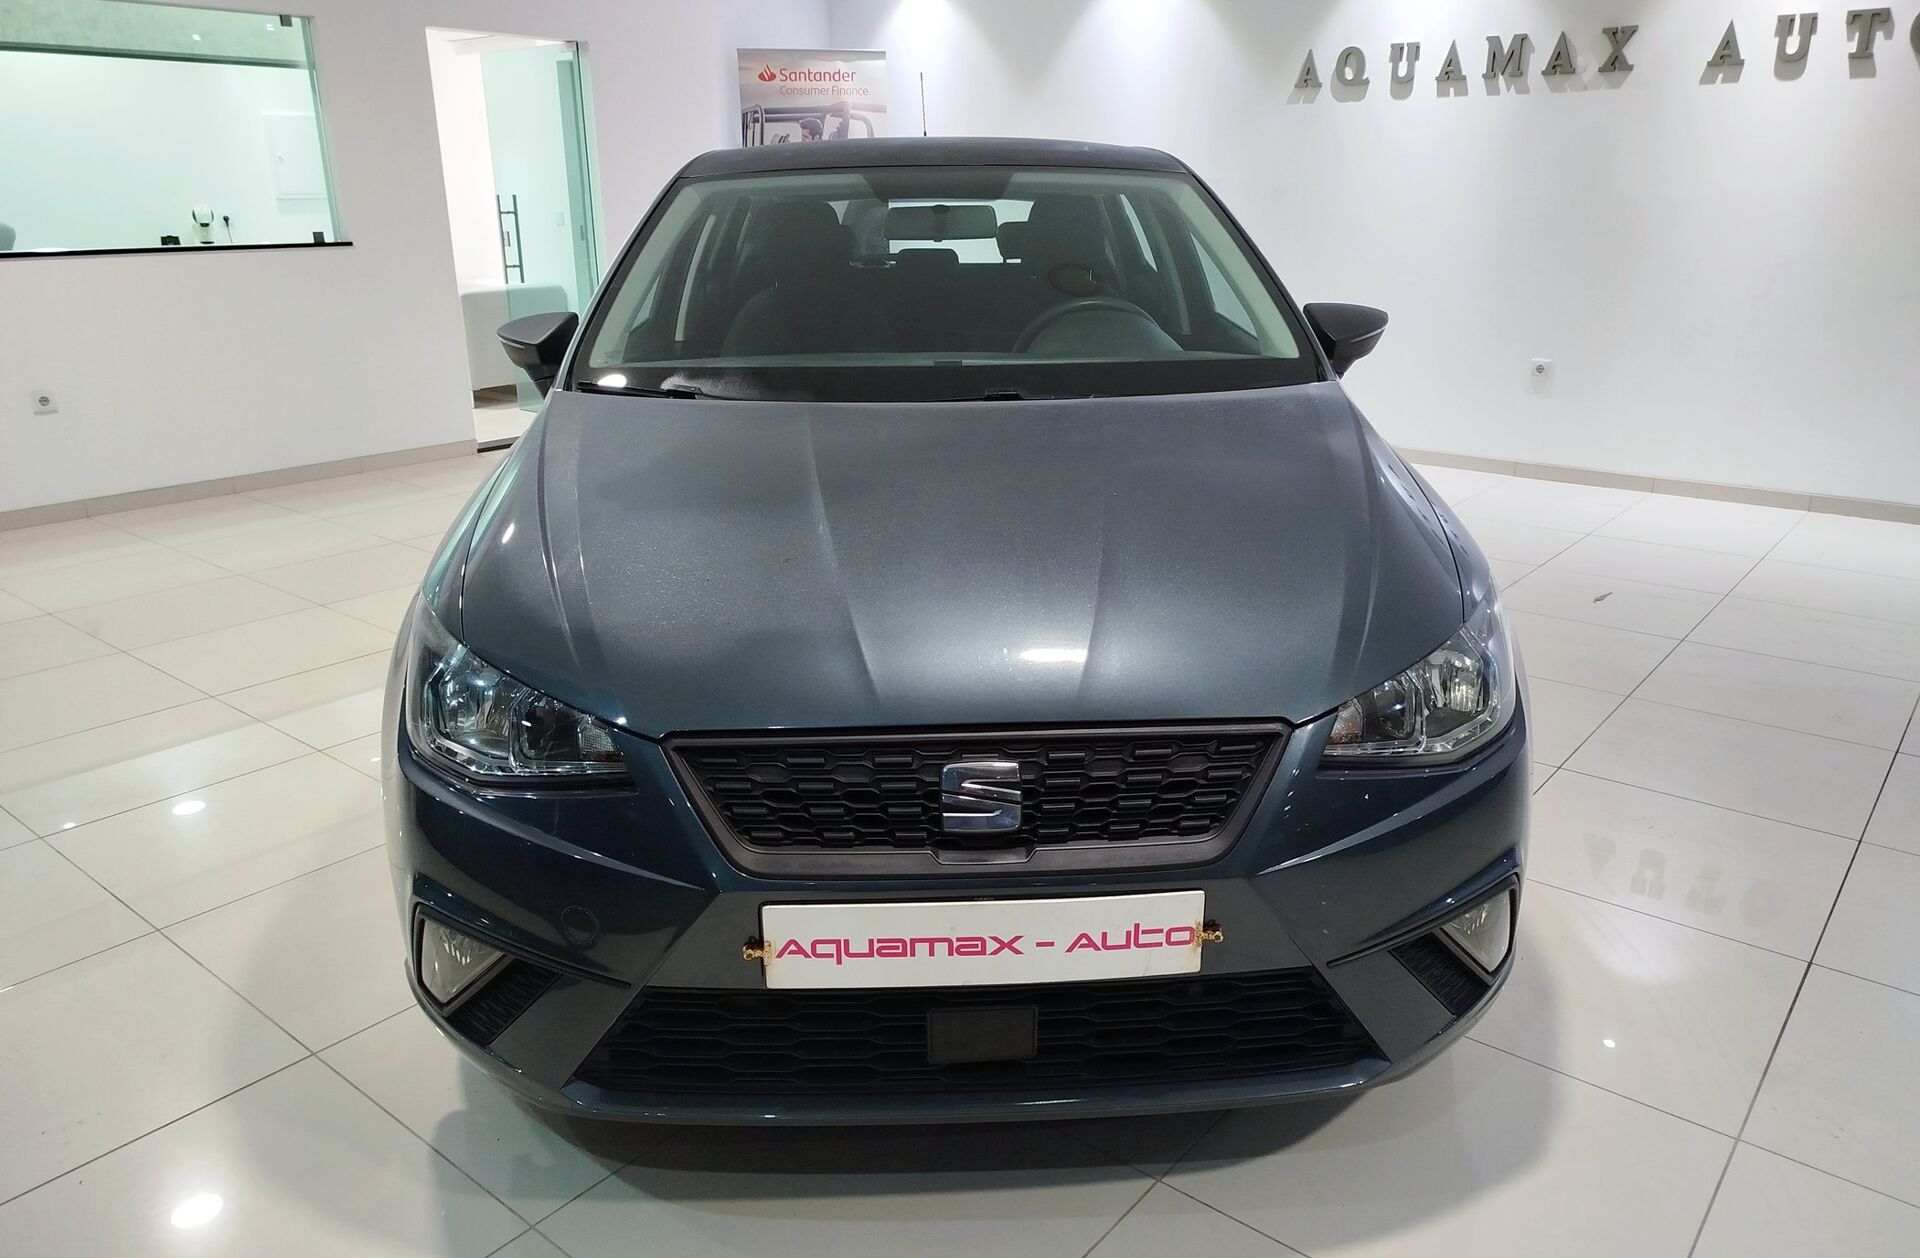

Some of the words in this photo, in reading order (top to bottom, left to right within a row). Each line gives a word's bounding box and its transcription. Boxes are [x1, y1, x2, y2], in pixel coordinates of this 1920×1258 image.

[1295, 24, 1639, 89] AQUAMAX
[1706, 7, 1920, 67] AUT
[779, 67, 857, 83] Santander
[779, 85, 830, 96] Consumer
[831, 85, 870, 97] Finance
[775, 934, 1025, 966] Aquamax
[1064, 922, 1196, 953] Auto
